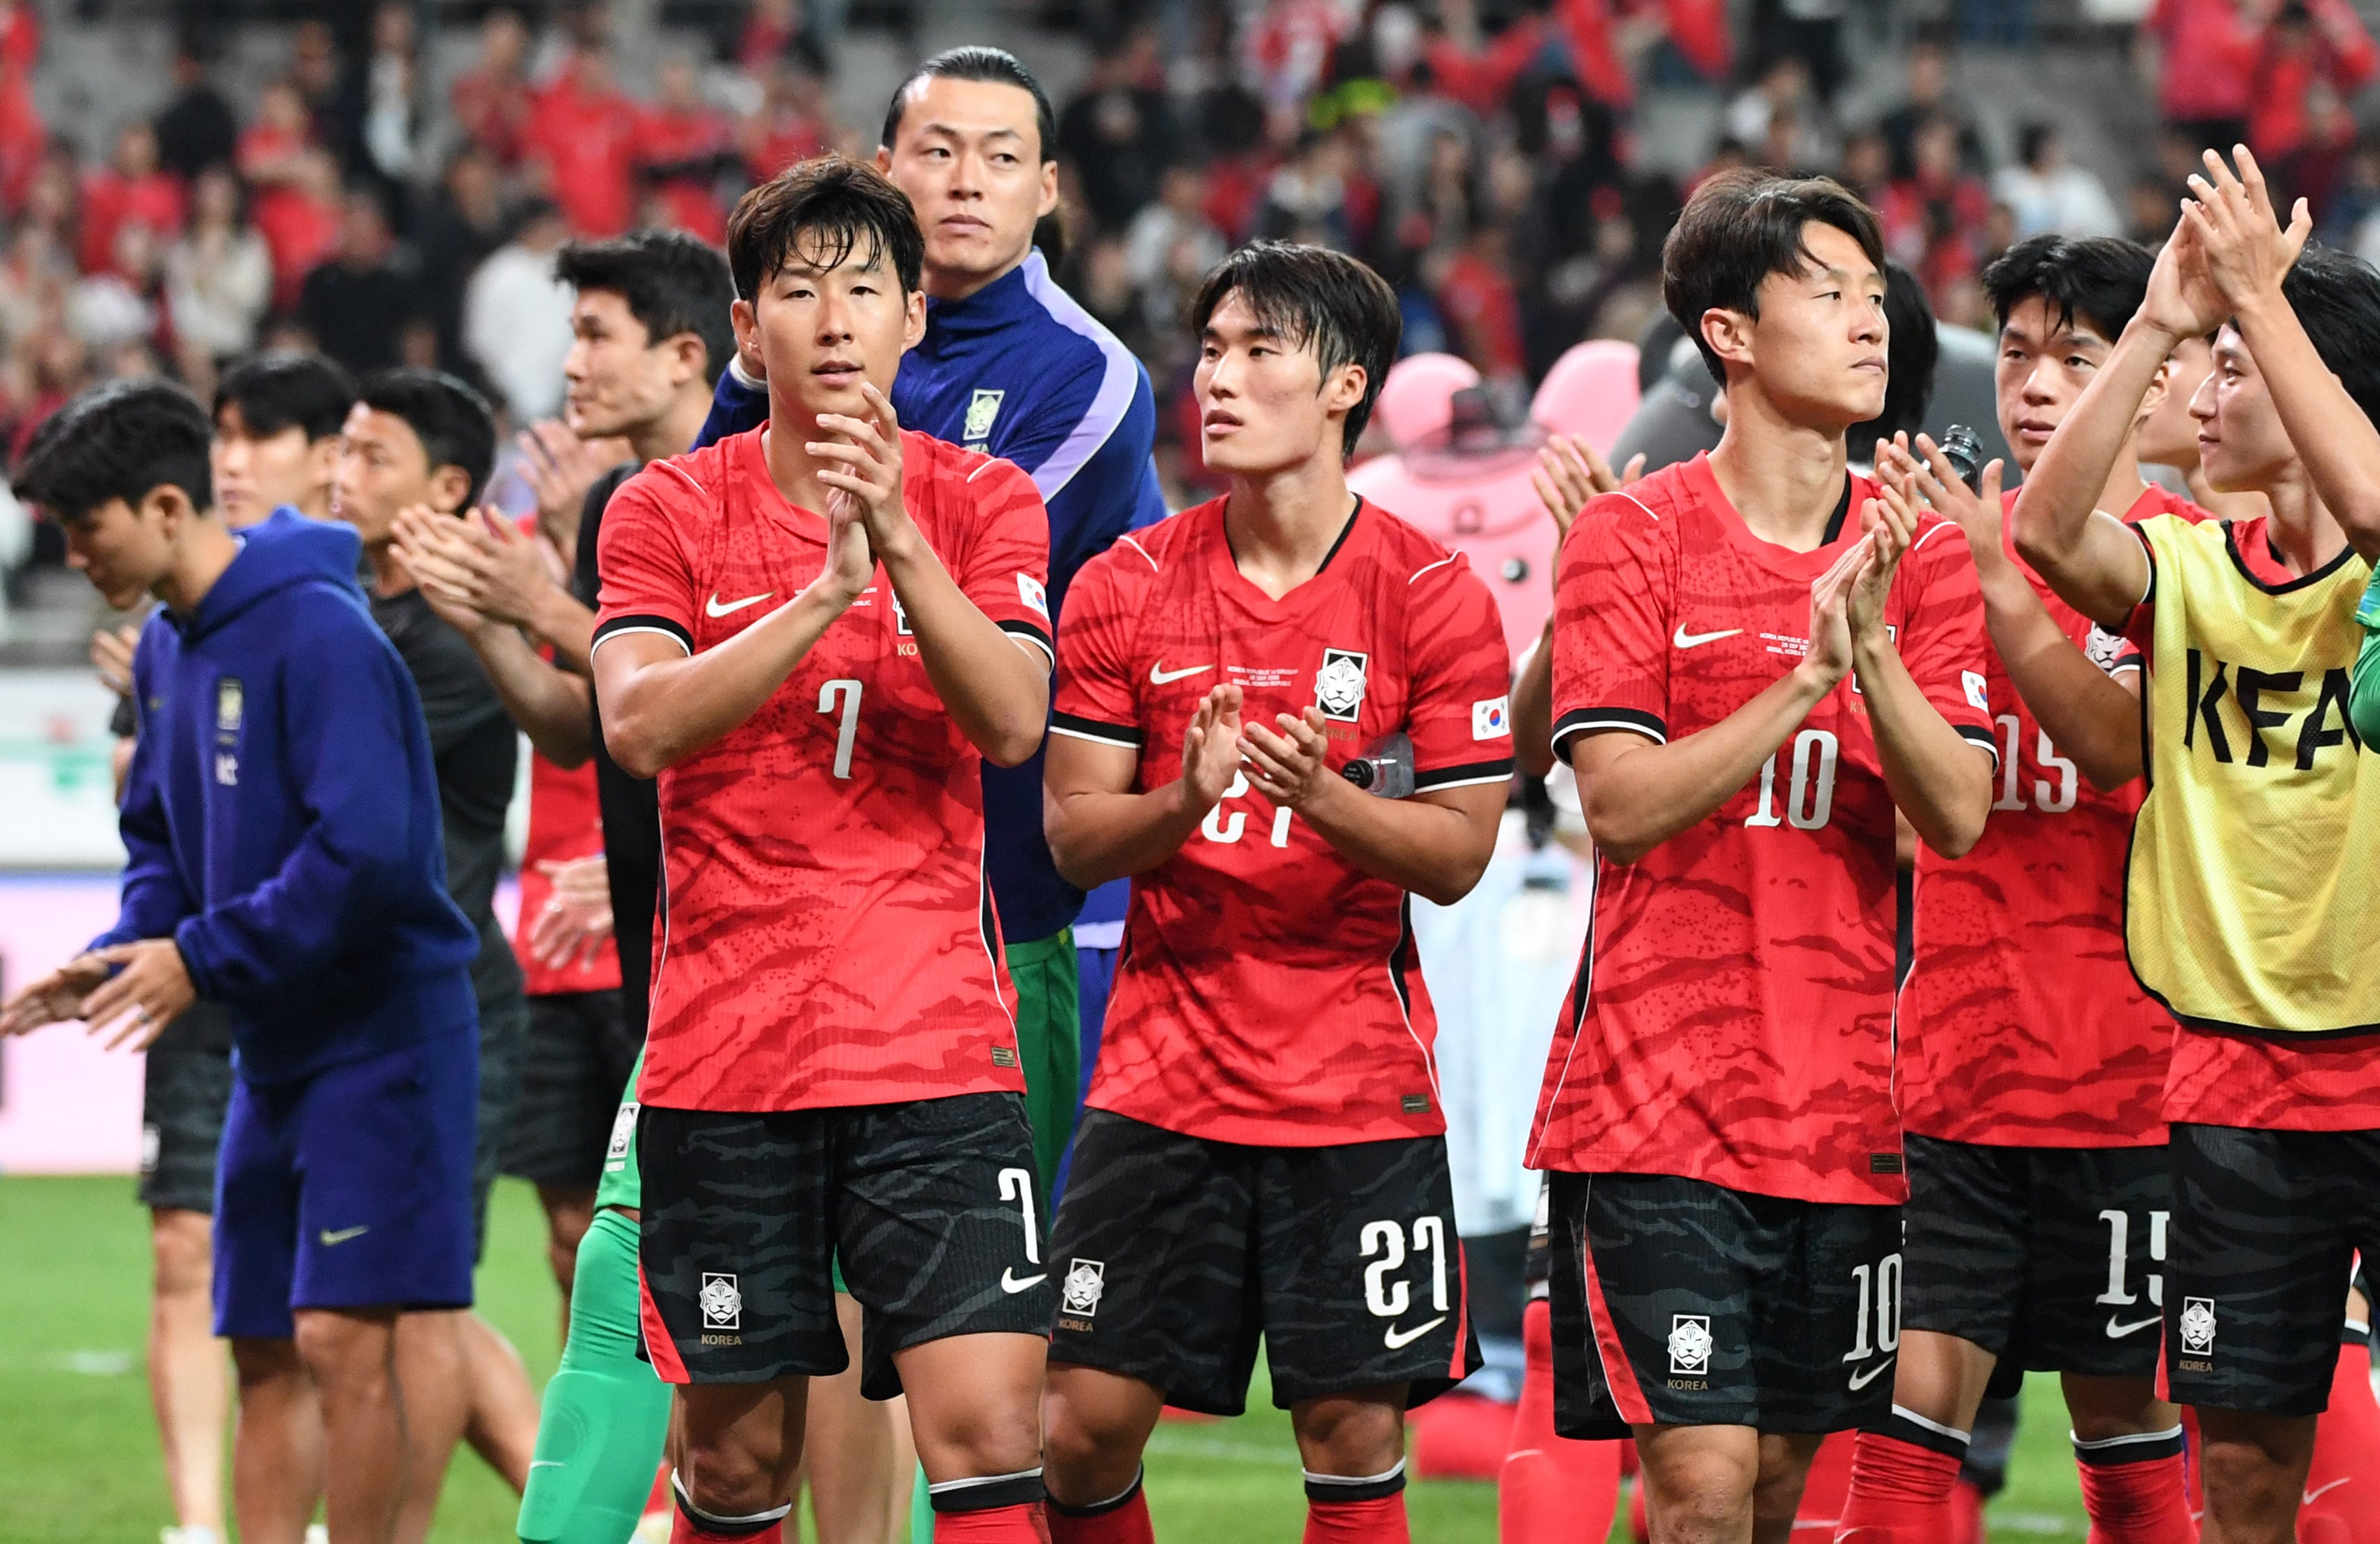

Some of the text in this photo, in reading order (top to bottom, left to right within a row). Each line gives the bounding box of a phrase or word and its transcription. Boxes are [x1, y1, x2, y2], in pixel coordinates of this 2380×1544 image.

[816, 679, 863, 779] 7
[2183, 648, 2360, 772] KFA
[1744, 730, 1838, 830] 10
[1992, 715, 2078, 813] 15
[998, 1168, 1040, 1265] 7
[1359, 1216, 1450, 1317] 27
[1842, 1252, 1903, 1364] 10
[702, 1334, 742, 1345] KOREA
[1058, 1318, 1093, 1332] KOREA
[2179, 1359, 2213, 1372] KOREA
[1667, 1379, 1708, 1391] KOREA
